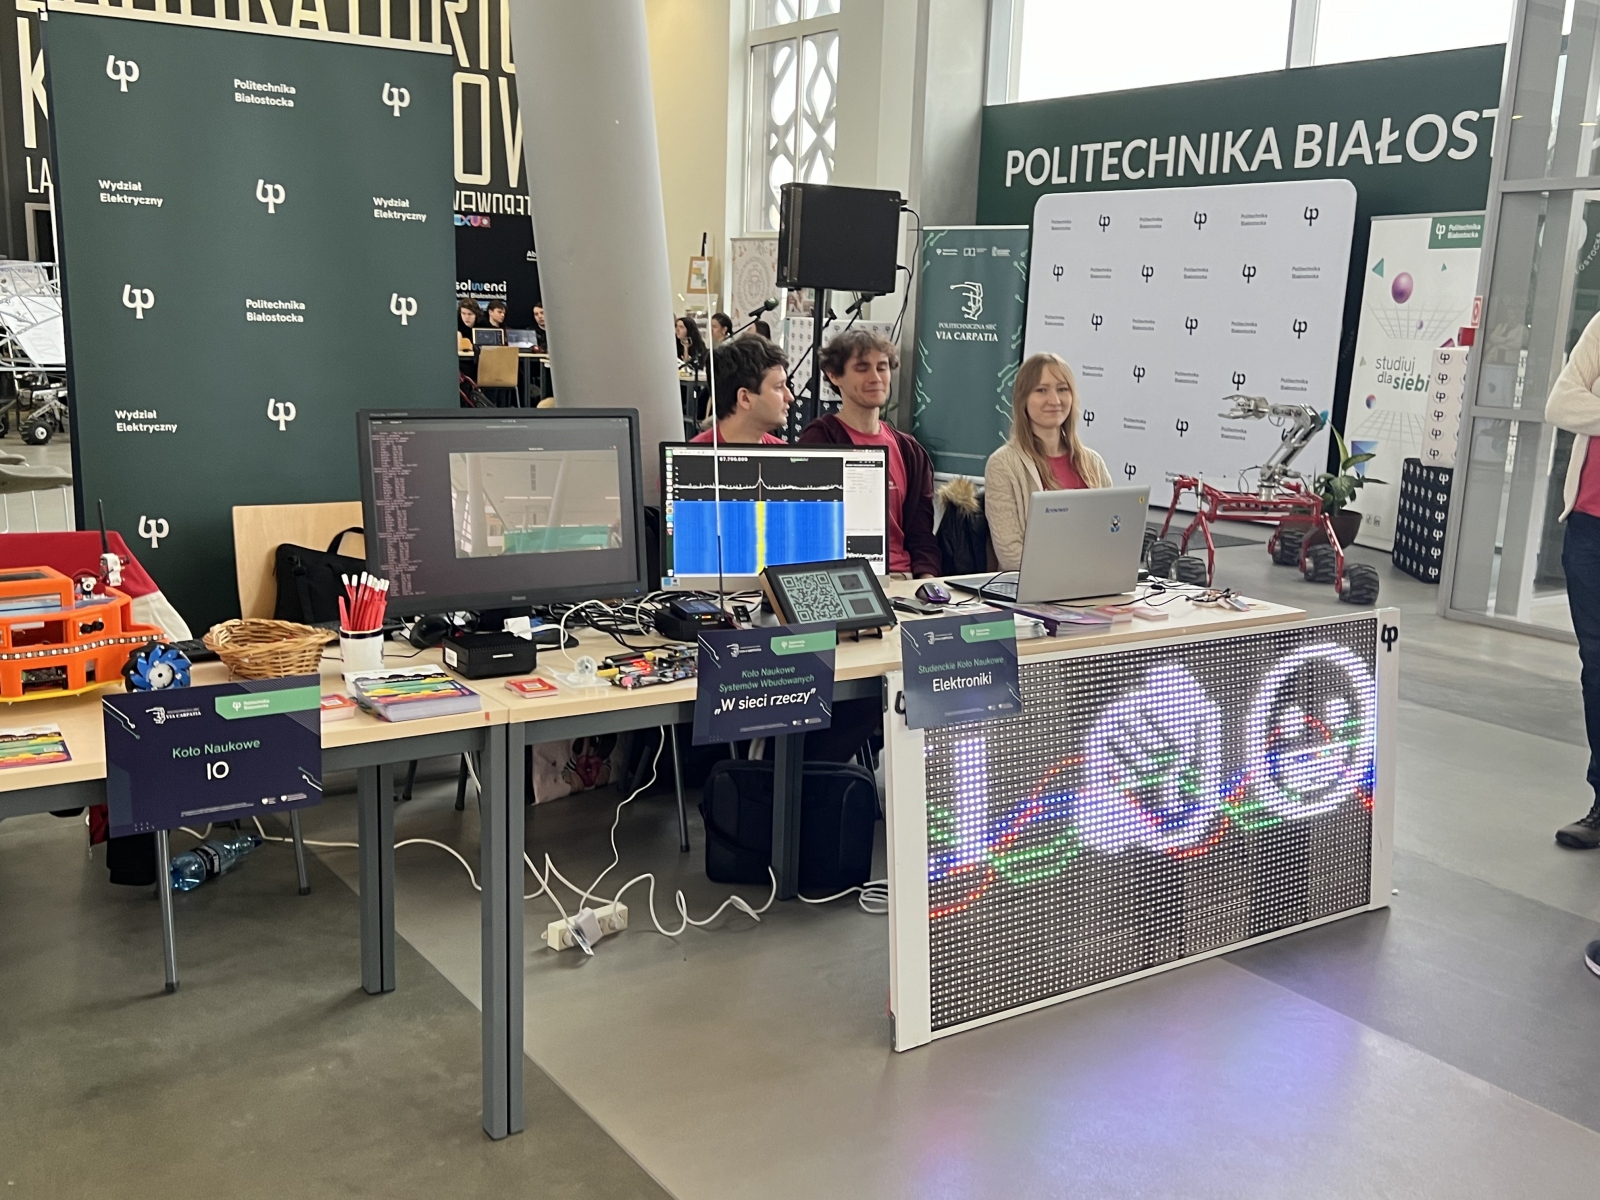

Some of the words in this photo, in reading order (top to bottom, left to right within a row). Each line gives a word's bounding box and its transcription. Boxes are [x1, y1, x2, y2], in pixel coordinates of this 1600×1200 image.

[233, 78, 296, 95] Politechnika
[234, 92, 294, 108] Białostocka
[1005, 126, 1283, 188] POLITECHNIKA
[98, 179, 142, 193] Wydział
[100, 193, 163, 208] Elektryczny
[373, 196, 409, 210] Wydział
[374, 209, 427, 223] Elektryczny
[245, 299, 306, 310] Politechnika
[246, 312, 304, 323] Białostocka
[935, 331, 952, 340] VIA
[953, 332, 998, 342] CARPATIA
[1375, 356, 1416, 375] studiuj
[1377, 372, 1393, 384] dla
[115, 410, 157, 421] Wydział
[116, 422, 177, 433] Elektryczny
[742, 669, 759, 678] Koło
[761, 666, 796, 677] Naukowe
[918, 660, 956, 674] Studenckie
[957, 658, 973, 669] Koło
[973, 656, 1004, 667] Naukowe
[719, 682, 759, 694] Systemów
[760, 674, 815, 689] Wbudowanych
[932, 671, 992, 693] Elektroniki
[738, 694, 767, 710] sieci
[172, 747, 201, 759] Koło
[204, 739, 261, 755] Naukowe
